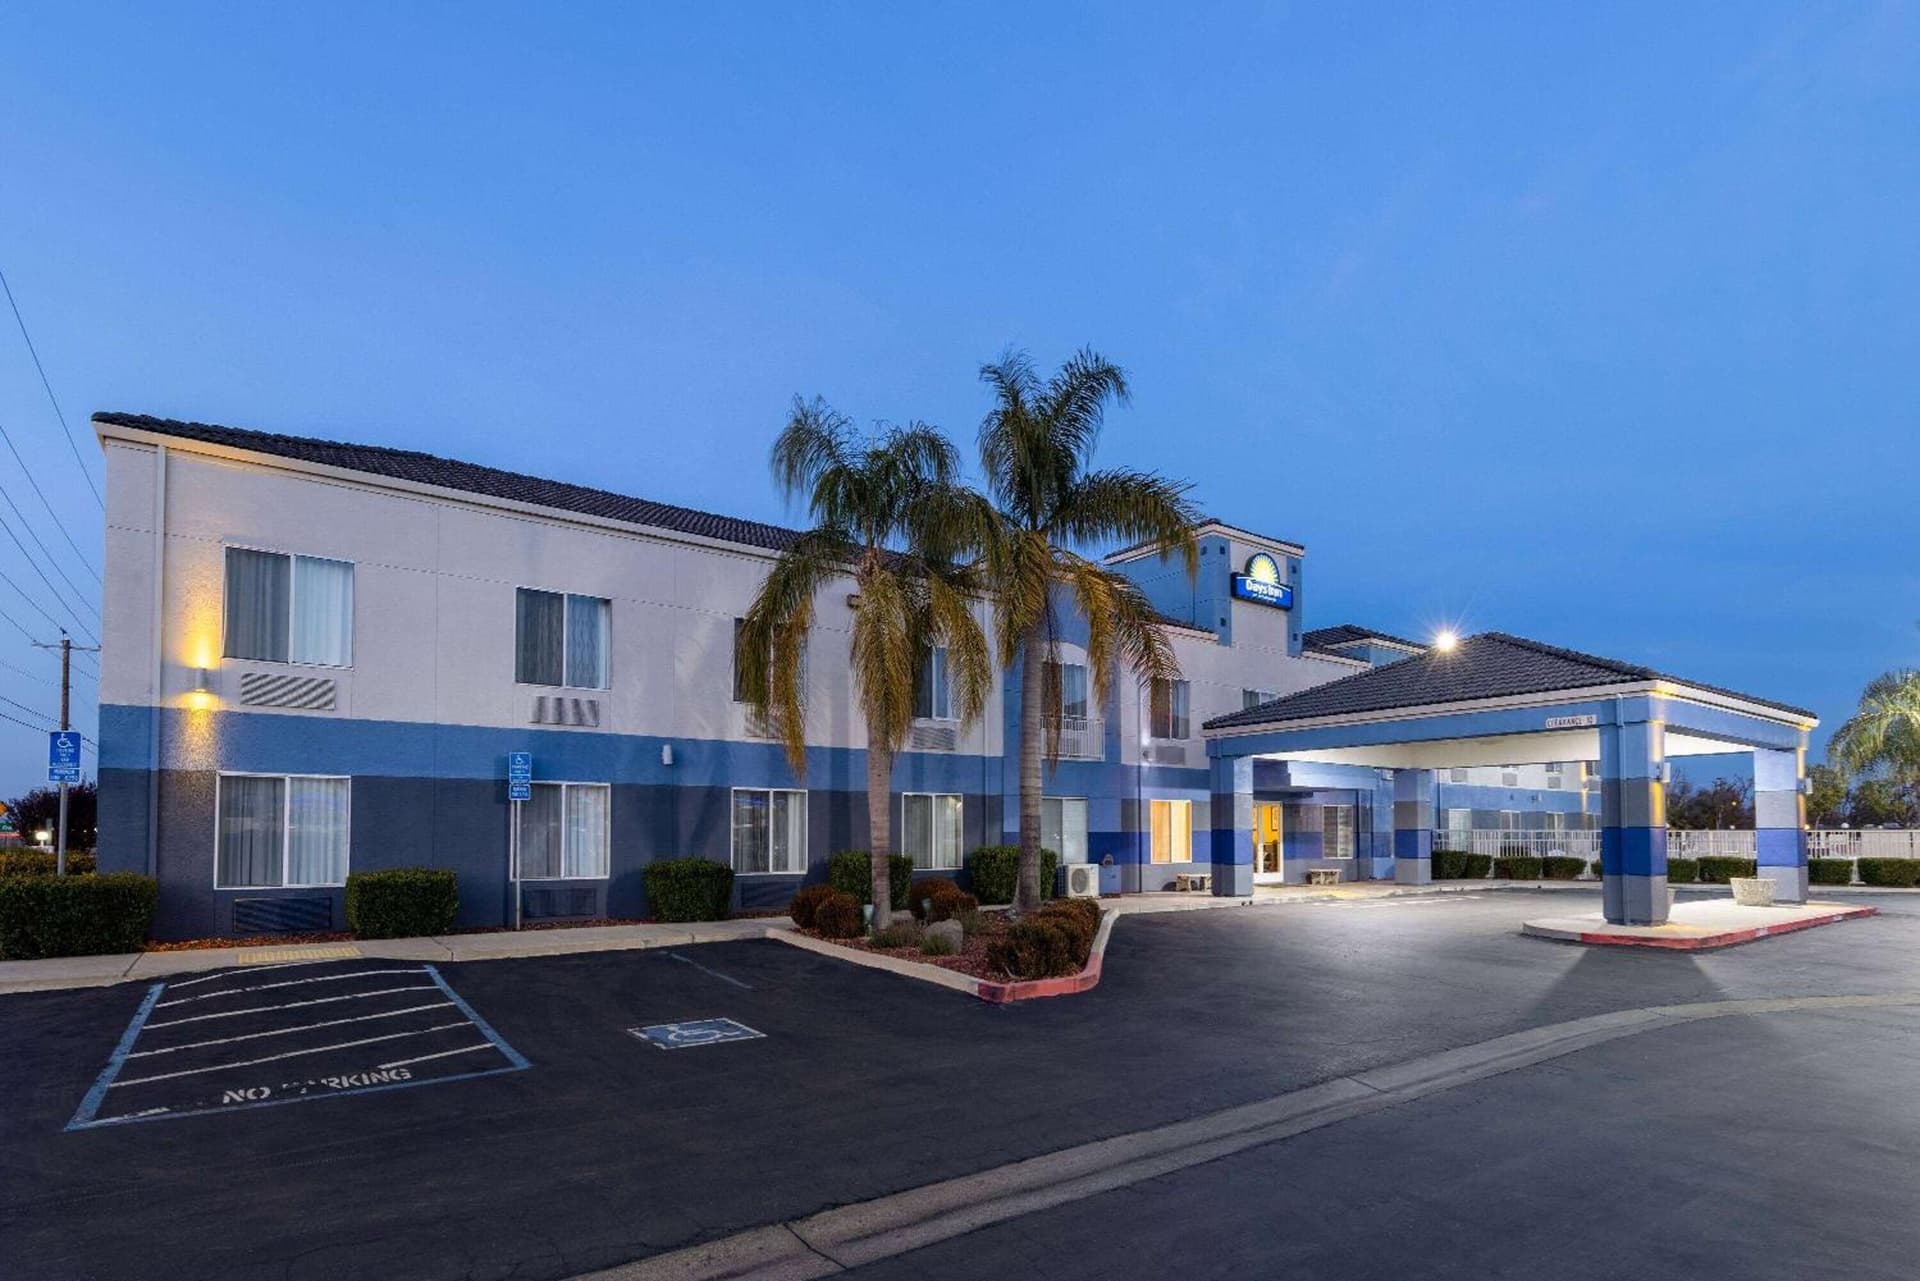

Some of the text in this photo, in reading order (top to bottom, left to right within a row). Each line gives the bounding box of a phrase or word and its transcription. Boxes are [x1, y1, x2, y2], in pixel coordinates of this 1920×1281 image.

[1246, 579, 1268, 595] Days
[1268, 584, 1283, 599] Inn
[222, 1068, 412, 1104] NO RKING
